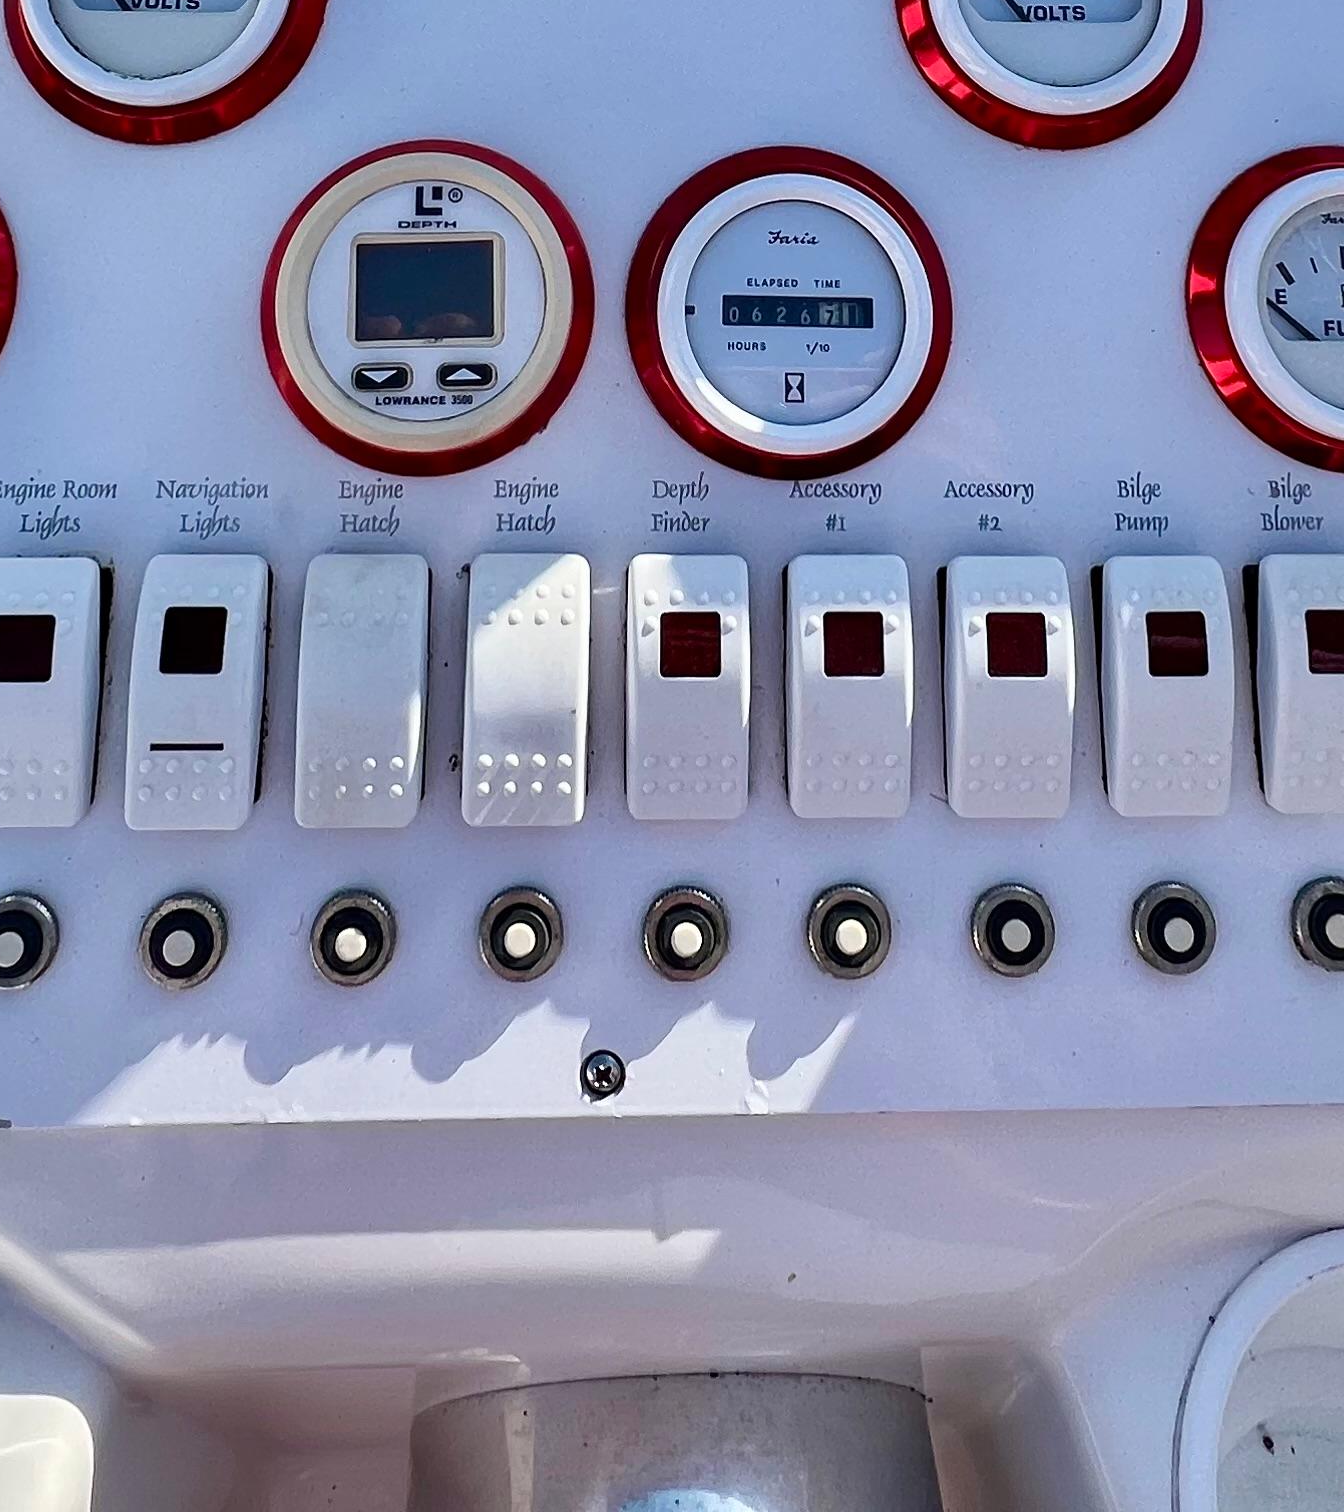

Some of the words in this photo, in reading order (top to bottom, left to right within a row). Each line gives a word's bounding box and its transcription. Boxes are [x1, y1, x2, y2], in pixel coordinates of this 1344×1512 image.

[1021, 6, 1085, 21] VOLTS
[398, 221, 457, 229] DEPTH
[747, 278, 798, 287] ELAPSED
[814, 279, 841, 288] TIME
[1275, 288, 1288, 305] E
[727, 342, 767, 351] HOURS
[806, 342, 830, 355] 1/10
[375, 396, 446, 405] LOWRANCE
[62, 479, 118, 499] Room
[156, 476, 269, 506] Navigation
[338, 477, 404, 506] Engine
[493, 477, 559, 506] Engine
[651, 471, 709, 503] Depth
[788, 479, 882, 505] Accessory
[943, 479, 1034, 505] Accessory
[1117, 471, 1162, 505] Bilge
[1267, 472, 1312, 505] Bilge
[19, 504, 81, 540] Lights
[179, 504, 241, 540] Lights
[339, 504, 401, 537] Hatch
[496, 504, 556, 535] Hatch
[651, 510, 710, 533] Finder
[825, 514, 846, 532] #1
[977, 513, 1002, 532] #2
[1114, 512, 1169, 538] Pump
[1260, 504, 1324, 532] Blower
